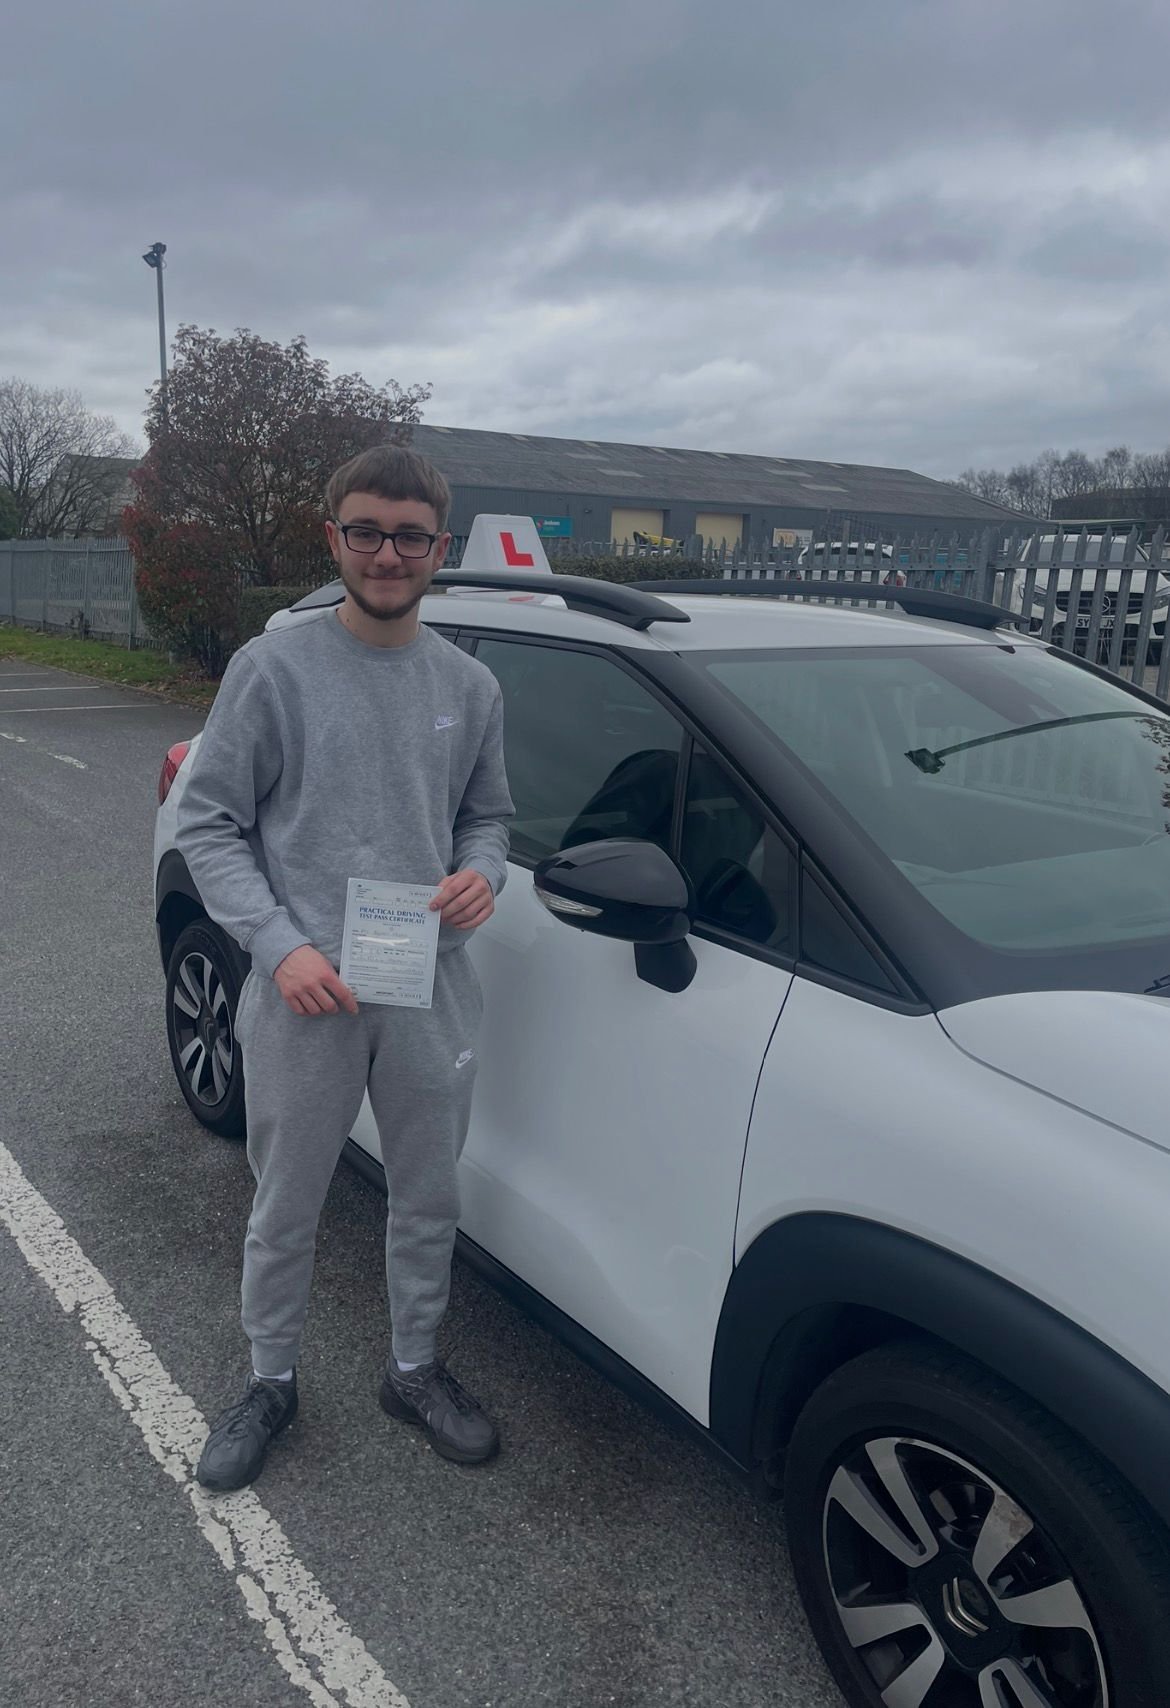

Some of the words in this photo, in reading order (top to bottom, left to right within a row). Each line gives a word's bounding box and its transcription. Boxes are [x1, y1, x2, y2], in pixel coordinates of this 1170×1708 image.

[500, 533, 534, 566] L
[360, 907, 394, 916] PRACTICAL
[397, 911, 426, 919] DRIVING
[390, 916, 425, 924] CERTIFICATE
